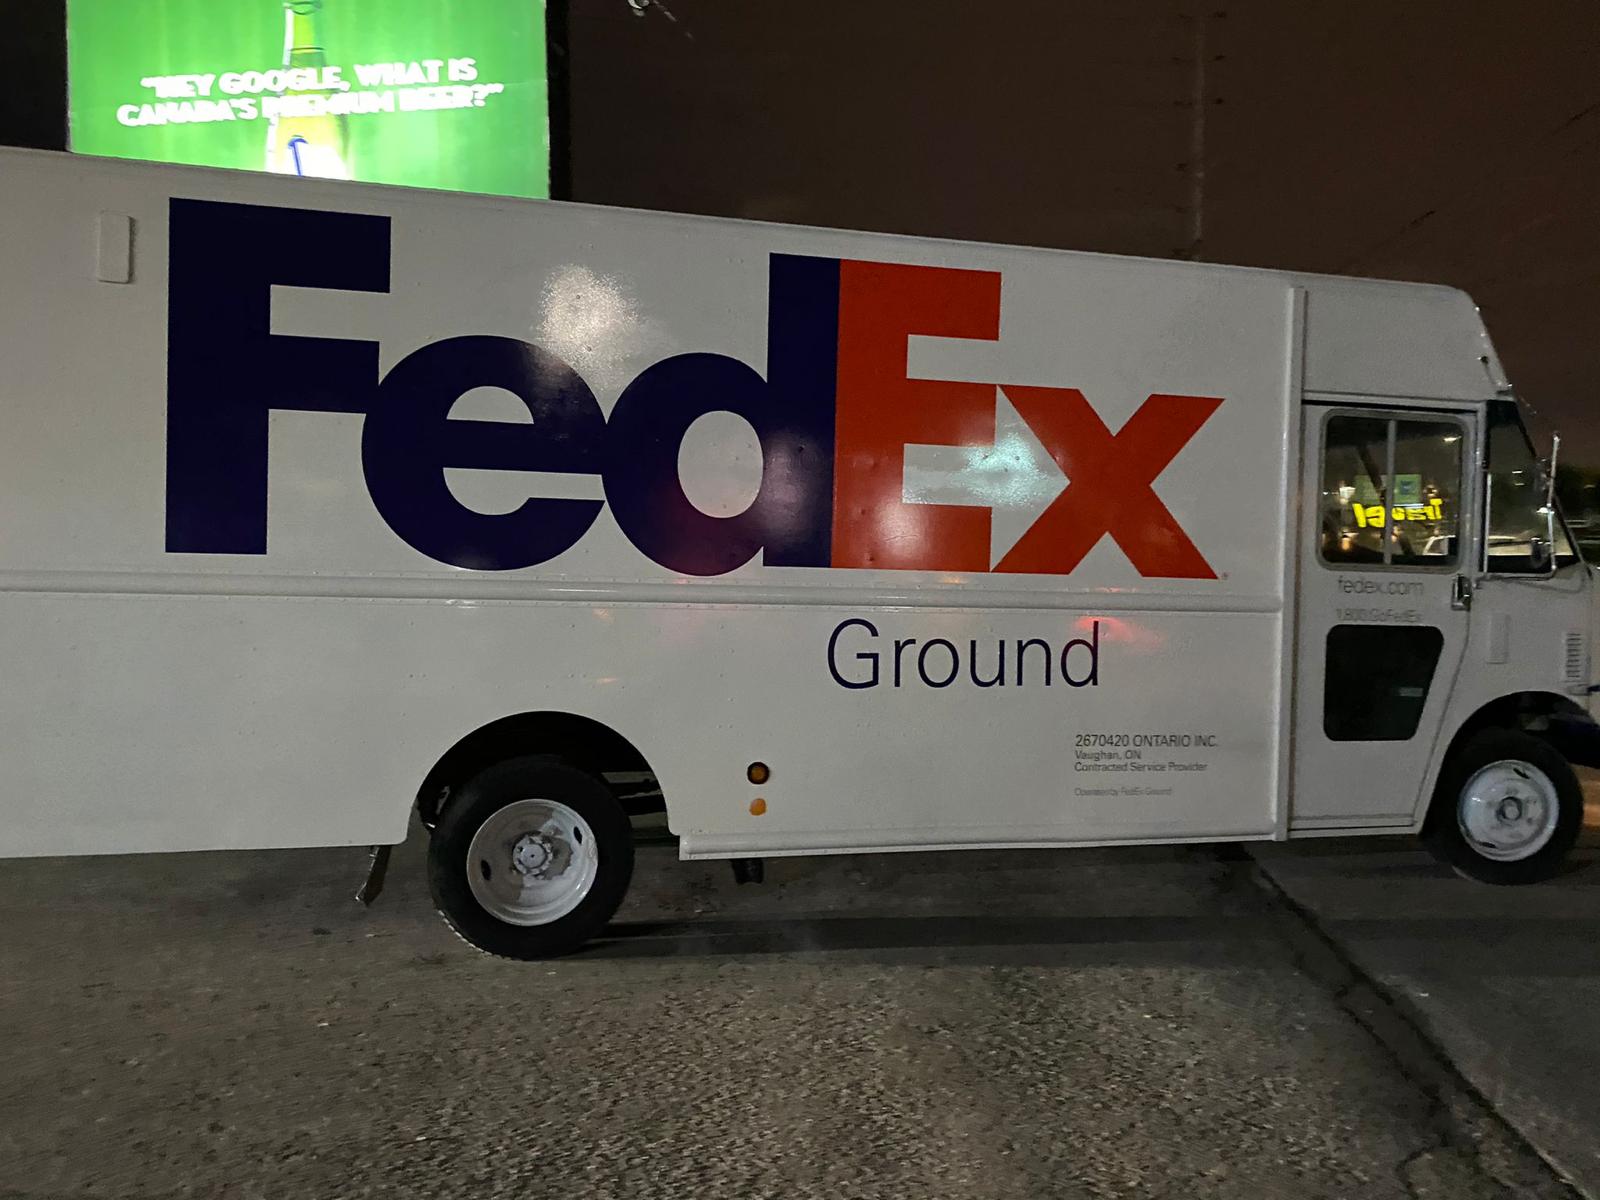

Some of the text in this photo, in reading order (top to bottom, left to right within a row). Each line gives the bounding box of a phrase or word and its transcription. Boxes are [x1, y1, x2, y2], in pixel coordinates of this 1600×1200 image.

[353, 59, 443, 87] WHAT
[448, 57, 477, 81] IS
[116, 97, 258, 126] CANADA'S
[165, 197, 1225, 579] FedEx
[1337, 575, 1424, 595] fedex.com
[827, 618, 1100, 689] Ground
[1075, 734, 1130, 747] 2670420
[1132, 734, 1191, 747] ONTARIO
[1125, 750, 1142, 759] ON
[1074, 762, 1208, 772] Contracted Service Provider
